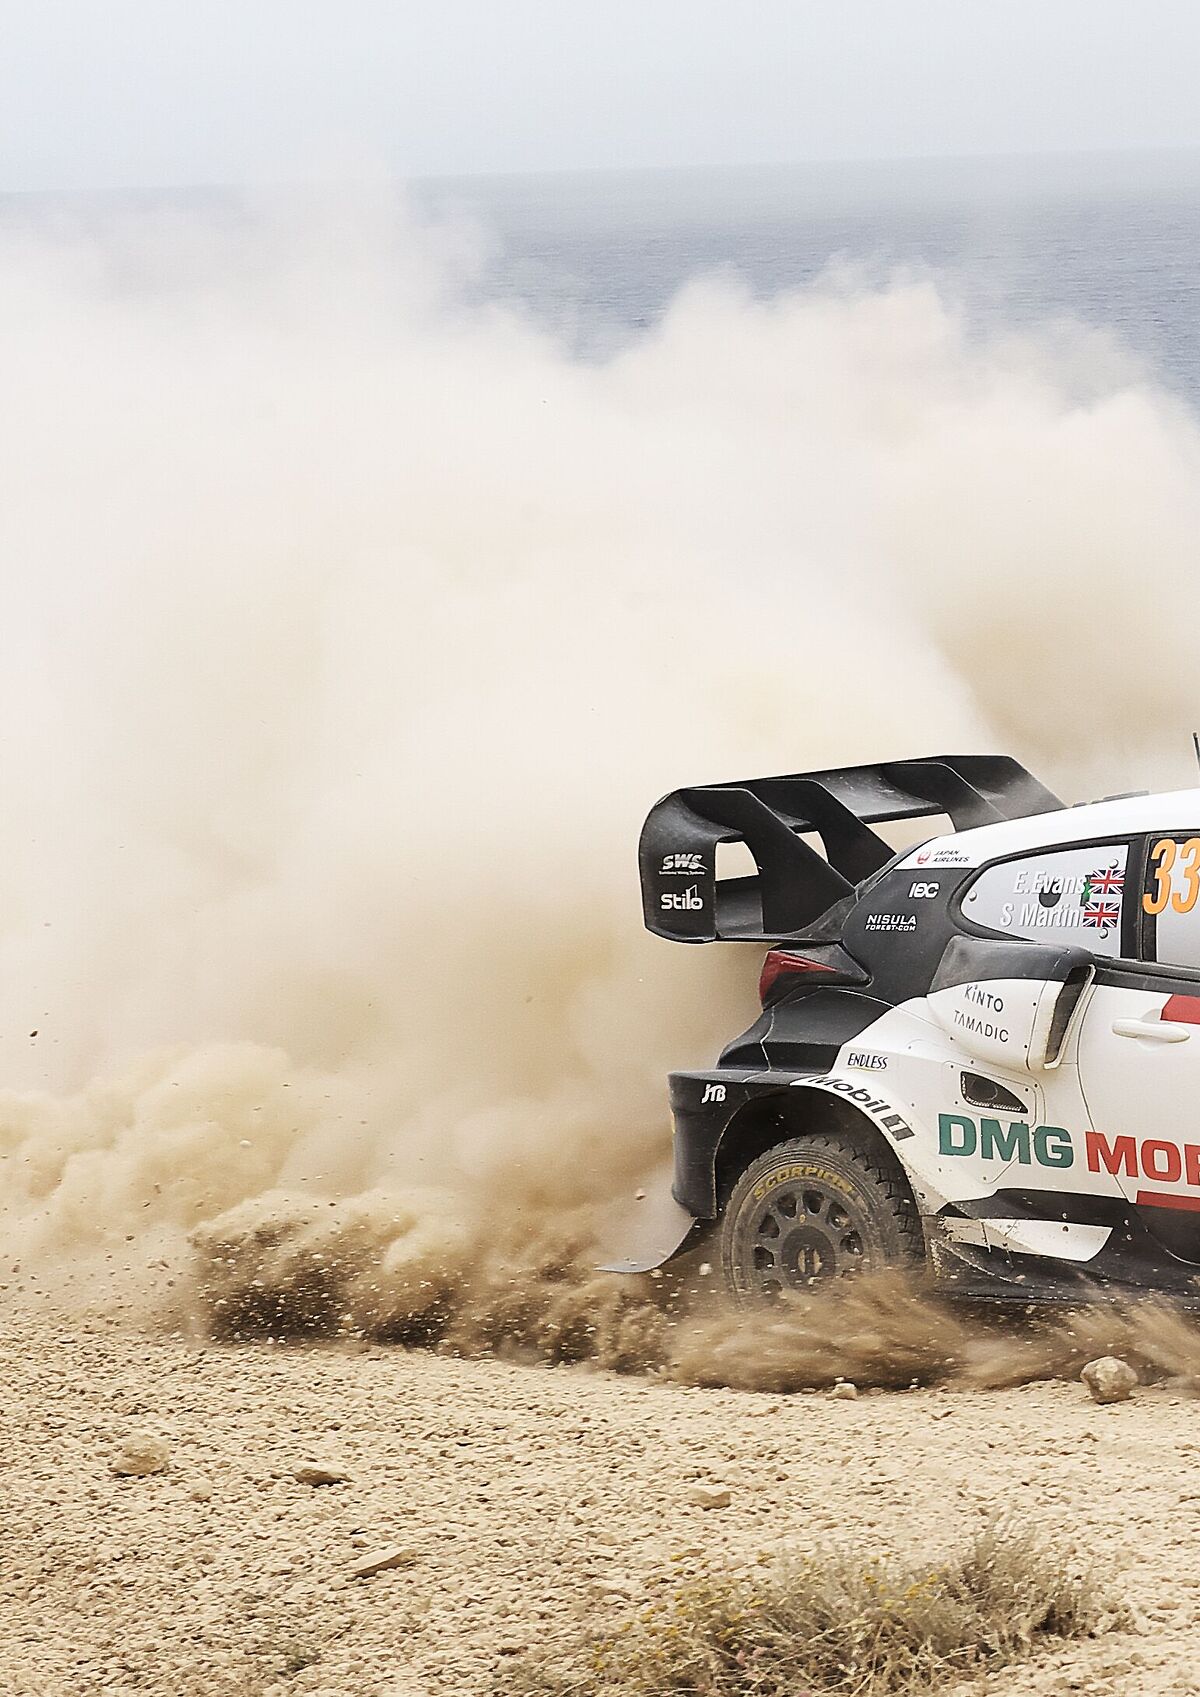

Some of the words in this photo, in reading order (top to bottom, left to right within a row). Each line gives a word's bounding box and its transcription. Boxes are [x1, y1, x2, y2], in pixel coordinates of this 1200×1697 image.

[662, 853, 708, 870] SWS
[660, 884, 704, 910] Stilo
[866, 914, 917, 925] NISULA
[1000, 903, 1014, 927] S
[1020, 903, 1081, 927] Martin
[953, 1009, 1009, 1043] TAMADIC
[847, 1053, 888, 1070] ENDLESS
[807, 1076, 892, 1114] Mobil
[938, 1113, 1074, 1169] DMG
